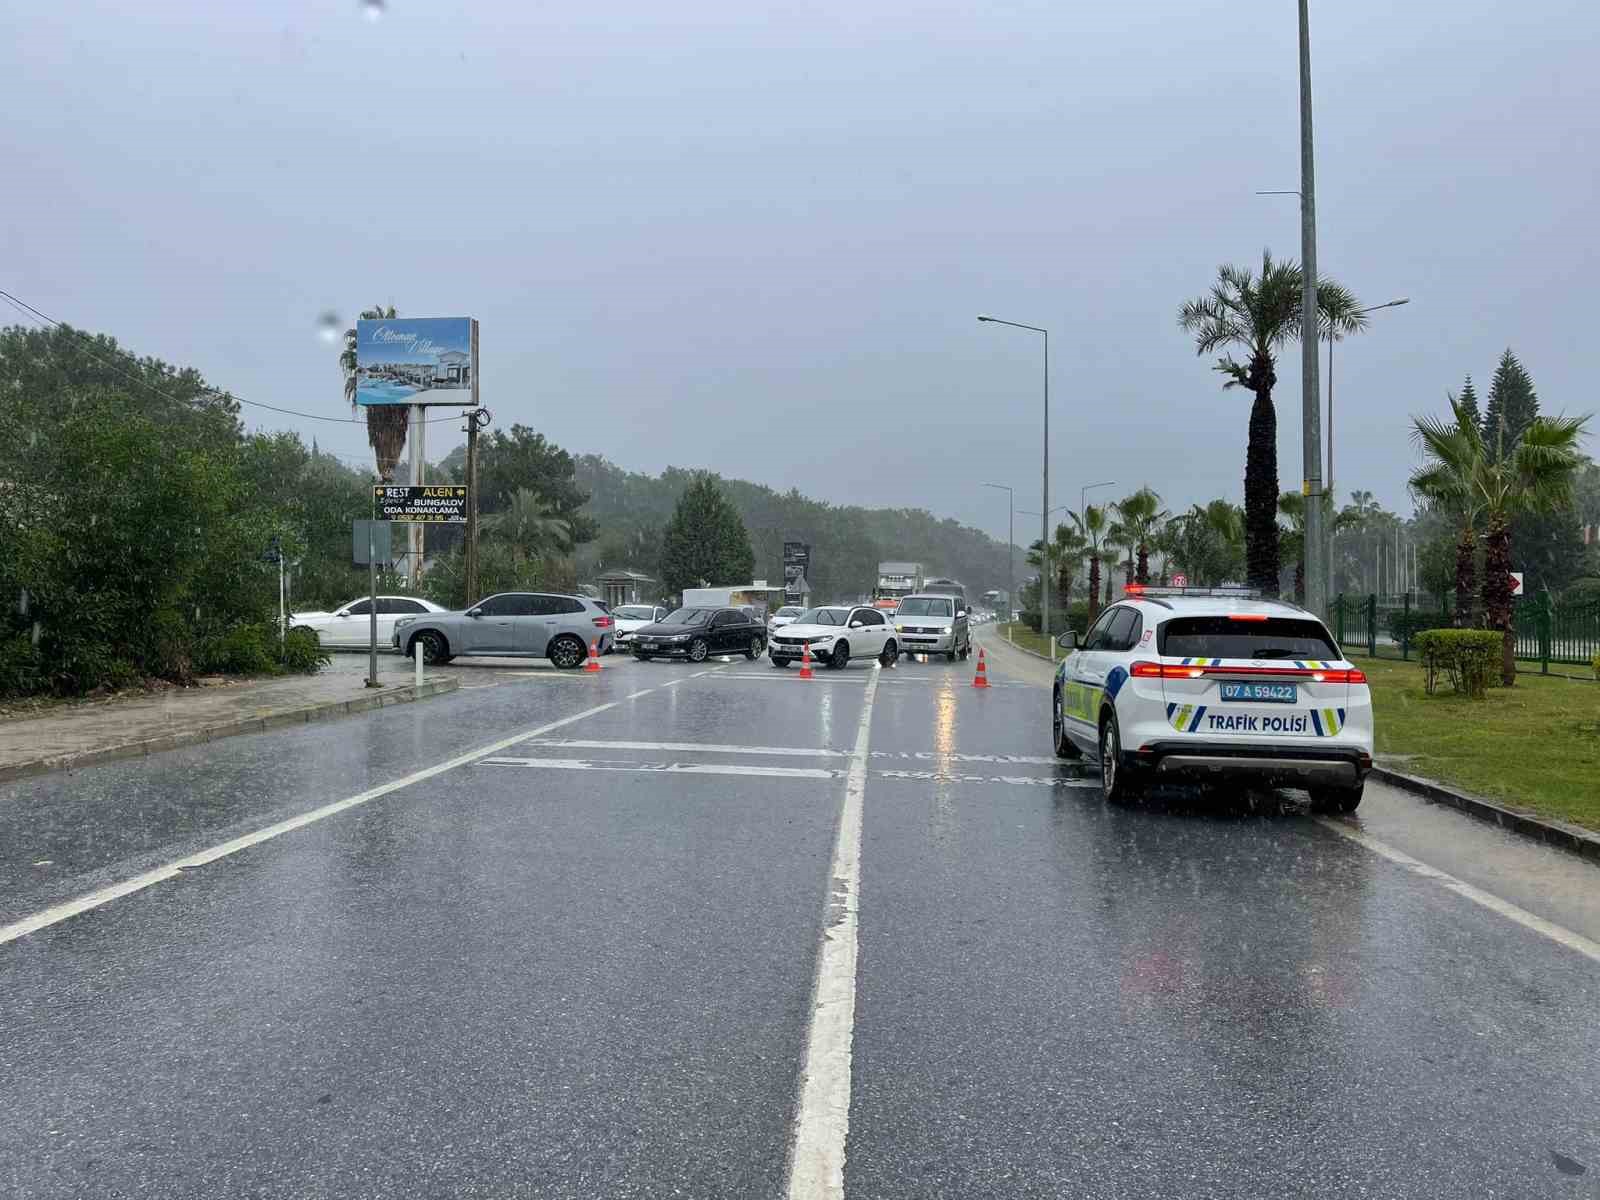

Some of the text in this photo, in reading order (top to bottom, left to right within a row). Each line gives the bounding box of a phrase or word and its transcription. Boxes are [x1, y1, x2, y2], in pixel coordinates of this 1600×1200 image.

[386, 487, 453, 498] REST ALEN
[384, 506, 460, 514] ODA KONAKLAMA
[1226, 686, 1293, 698] 07 A 59422
[1208, 714, 1308, 732] TRAFİK POLİSİ
